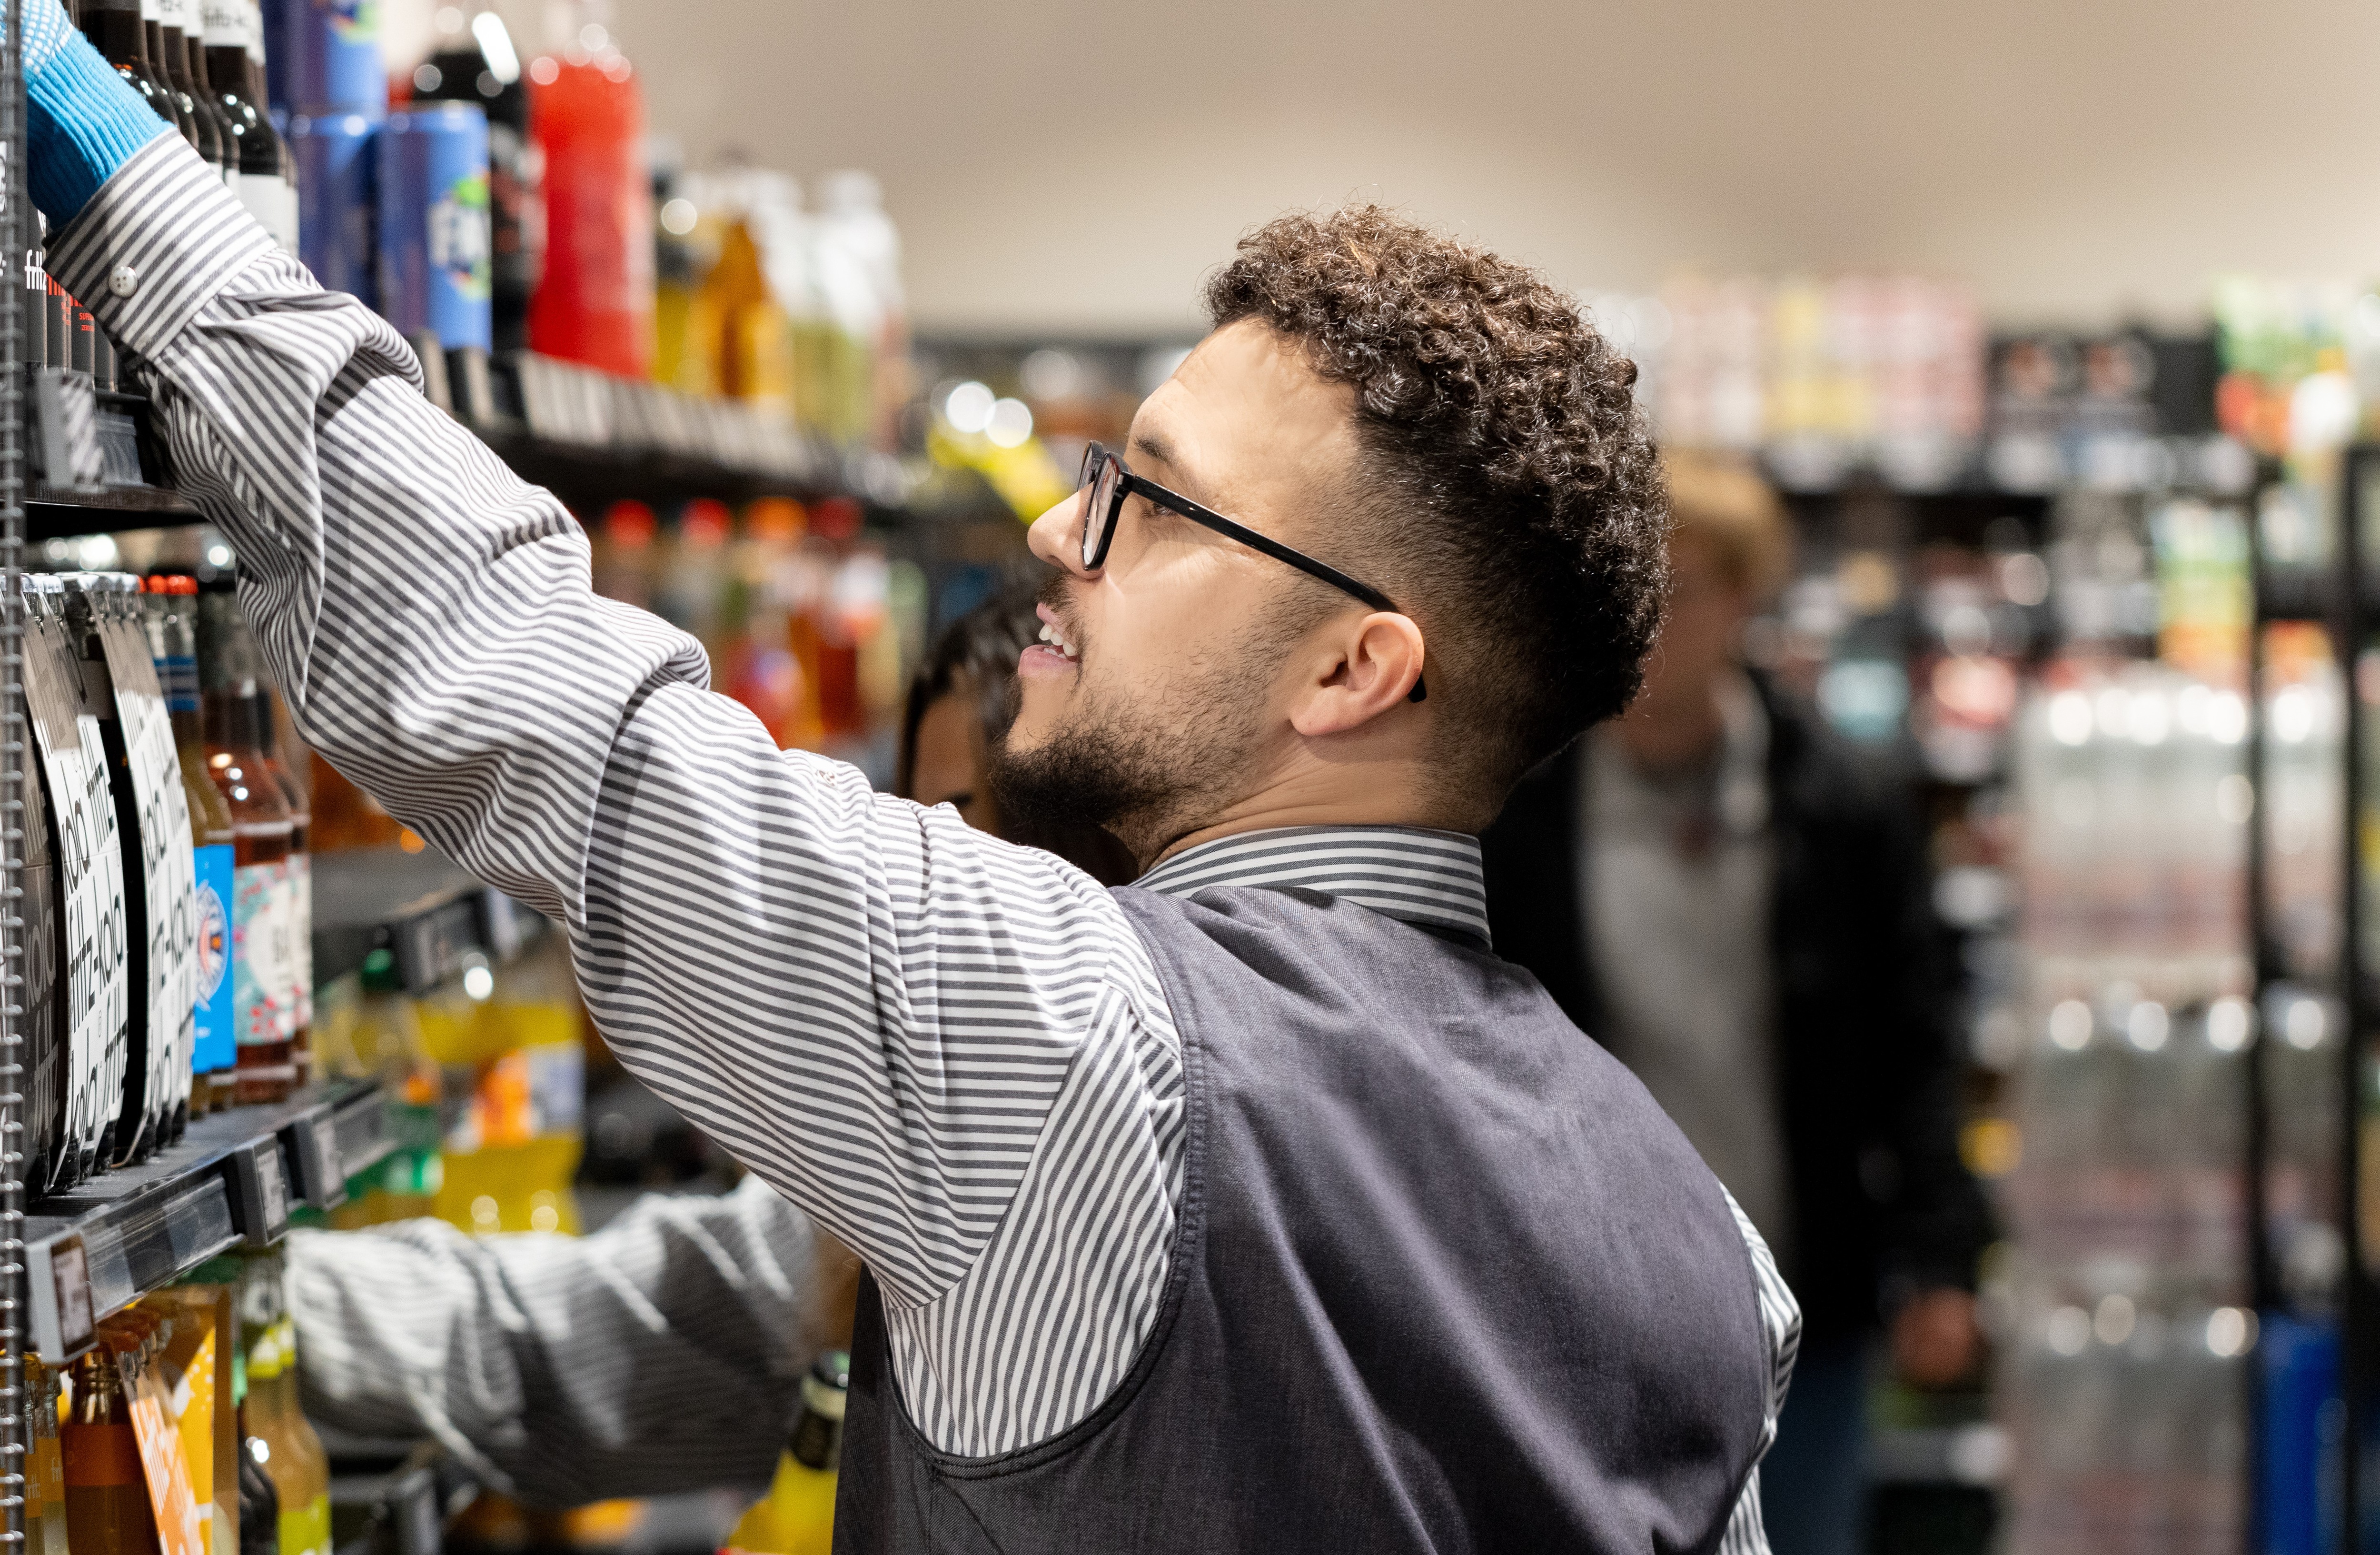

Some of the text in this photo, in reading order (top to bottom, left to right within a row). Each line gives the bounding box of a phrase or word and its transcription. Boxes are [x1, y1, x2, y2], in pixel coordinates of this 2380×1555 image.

[23, 867, 56, 1013] kola
[69, 855, 124, 1032] fritz-kola
[33, 1000, 58, 1141] fritz
